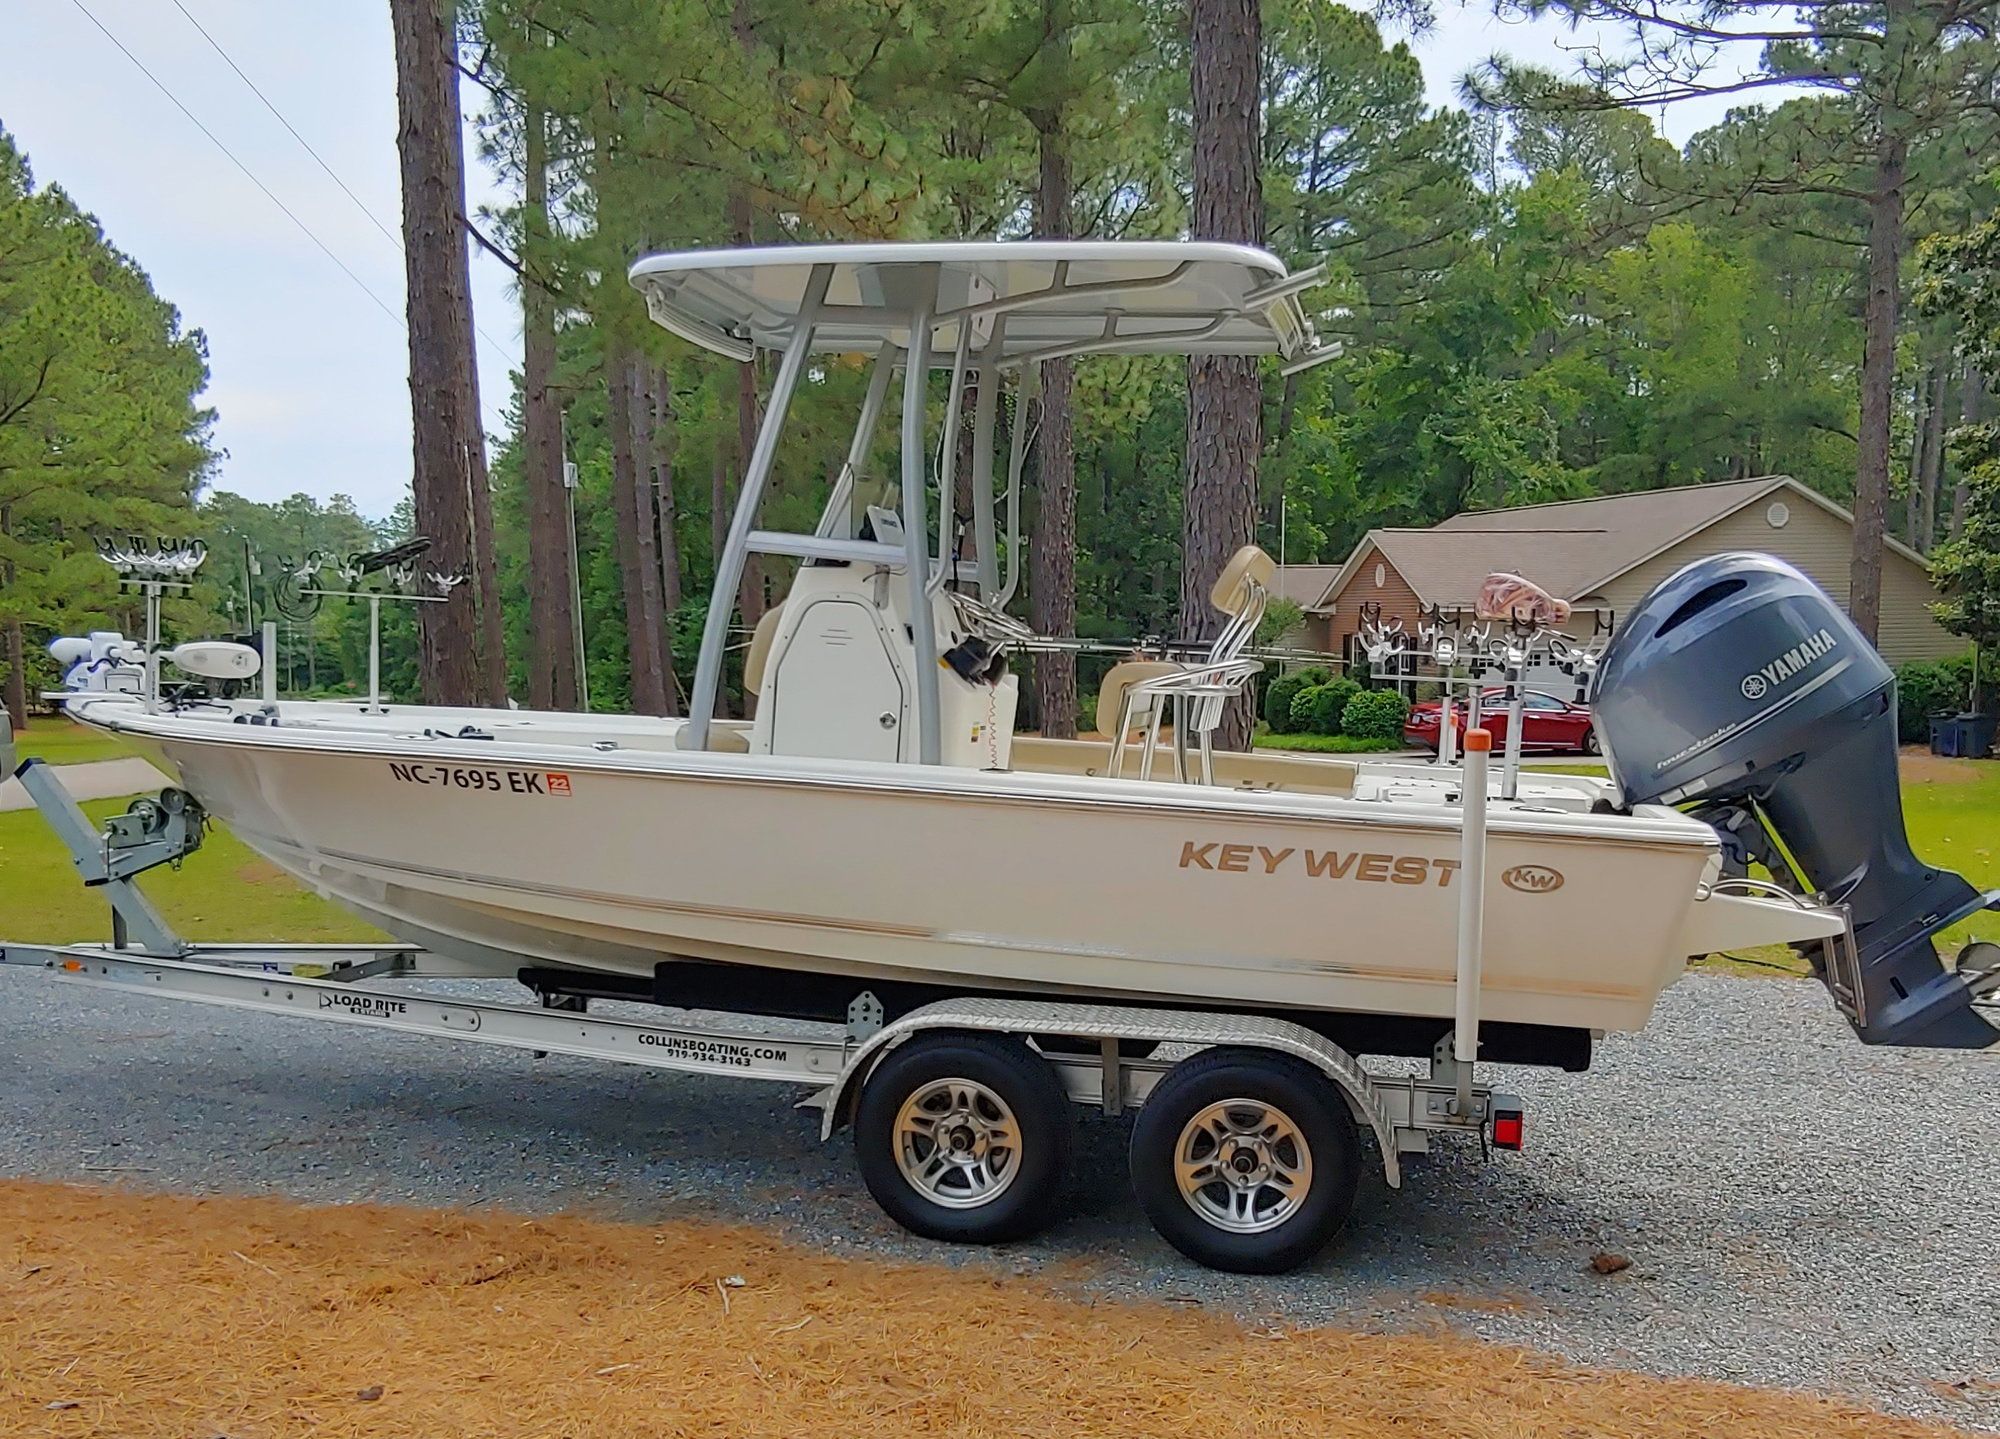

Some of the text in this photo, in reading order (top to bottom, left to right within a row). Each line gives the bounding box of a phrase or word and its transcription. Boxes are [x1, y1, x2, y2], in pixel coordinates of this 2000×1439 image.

[1760, 628, 1837, 686] YAMAHA
[389, 763, 545, 794] NC-7695 EK
[1179, 841, 1462, 887] KEY WEST
[1513, 869, 1555, 888] KW
[333, 994, 372, 1009] LOAD
[375, 999, 407, 1013] RITE
[638, 1034, 787, 1061] COLLINSBOATING.COM
